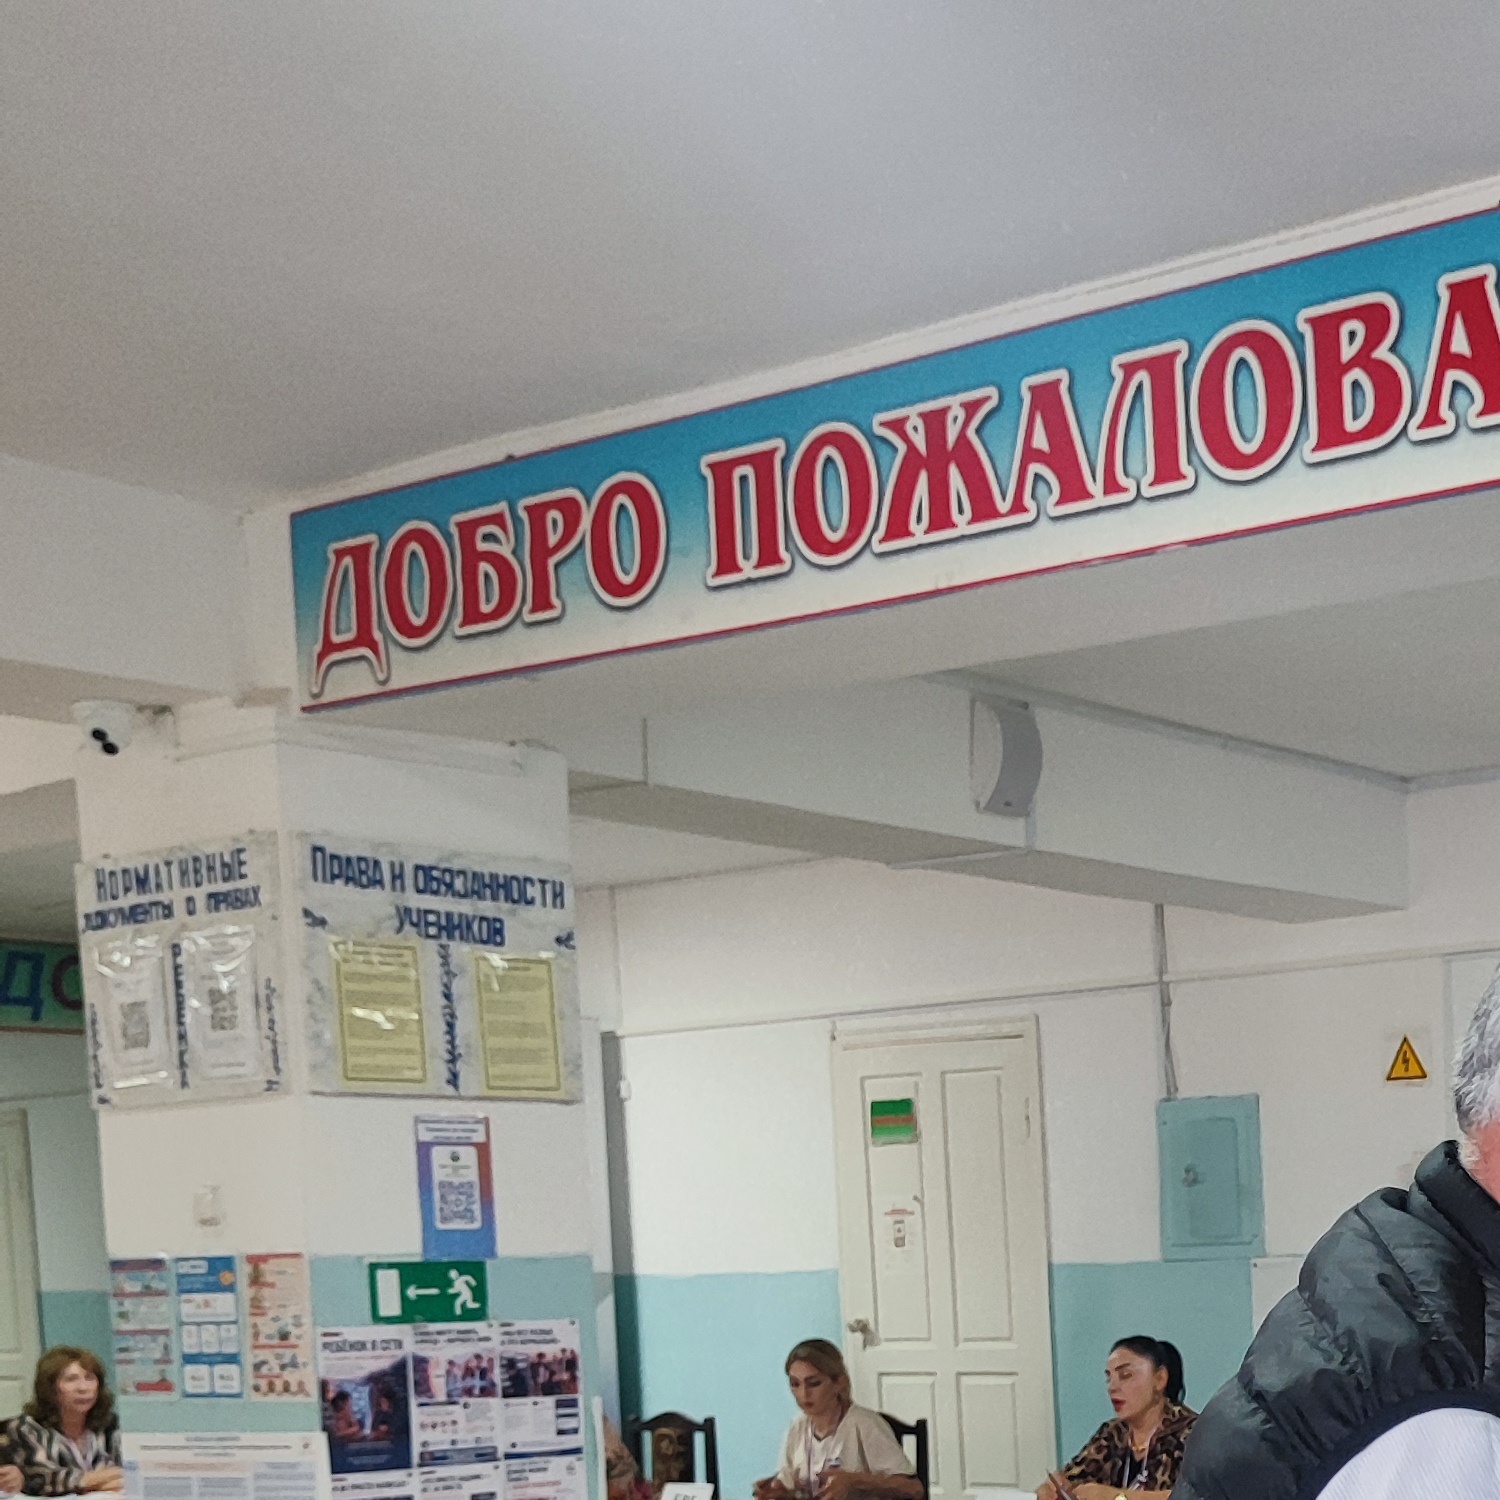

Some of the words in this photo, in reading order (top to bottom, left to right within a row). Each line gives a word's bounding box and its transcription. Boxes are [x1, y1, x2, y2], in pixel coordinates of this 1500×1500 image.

[313, 472, 666, 697] ДОБРО
[96, 847, 248, 902] НОРМАТИВНЫЕ
[311, 844, 385, 891] ПРАВА
[391, 860, 406, 893] И
[413, 863, 565, 910] ОБЯЗАННОСТИ
[395, 904, 505, 948] УЧЕНИКОВ
